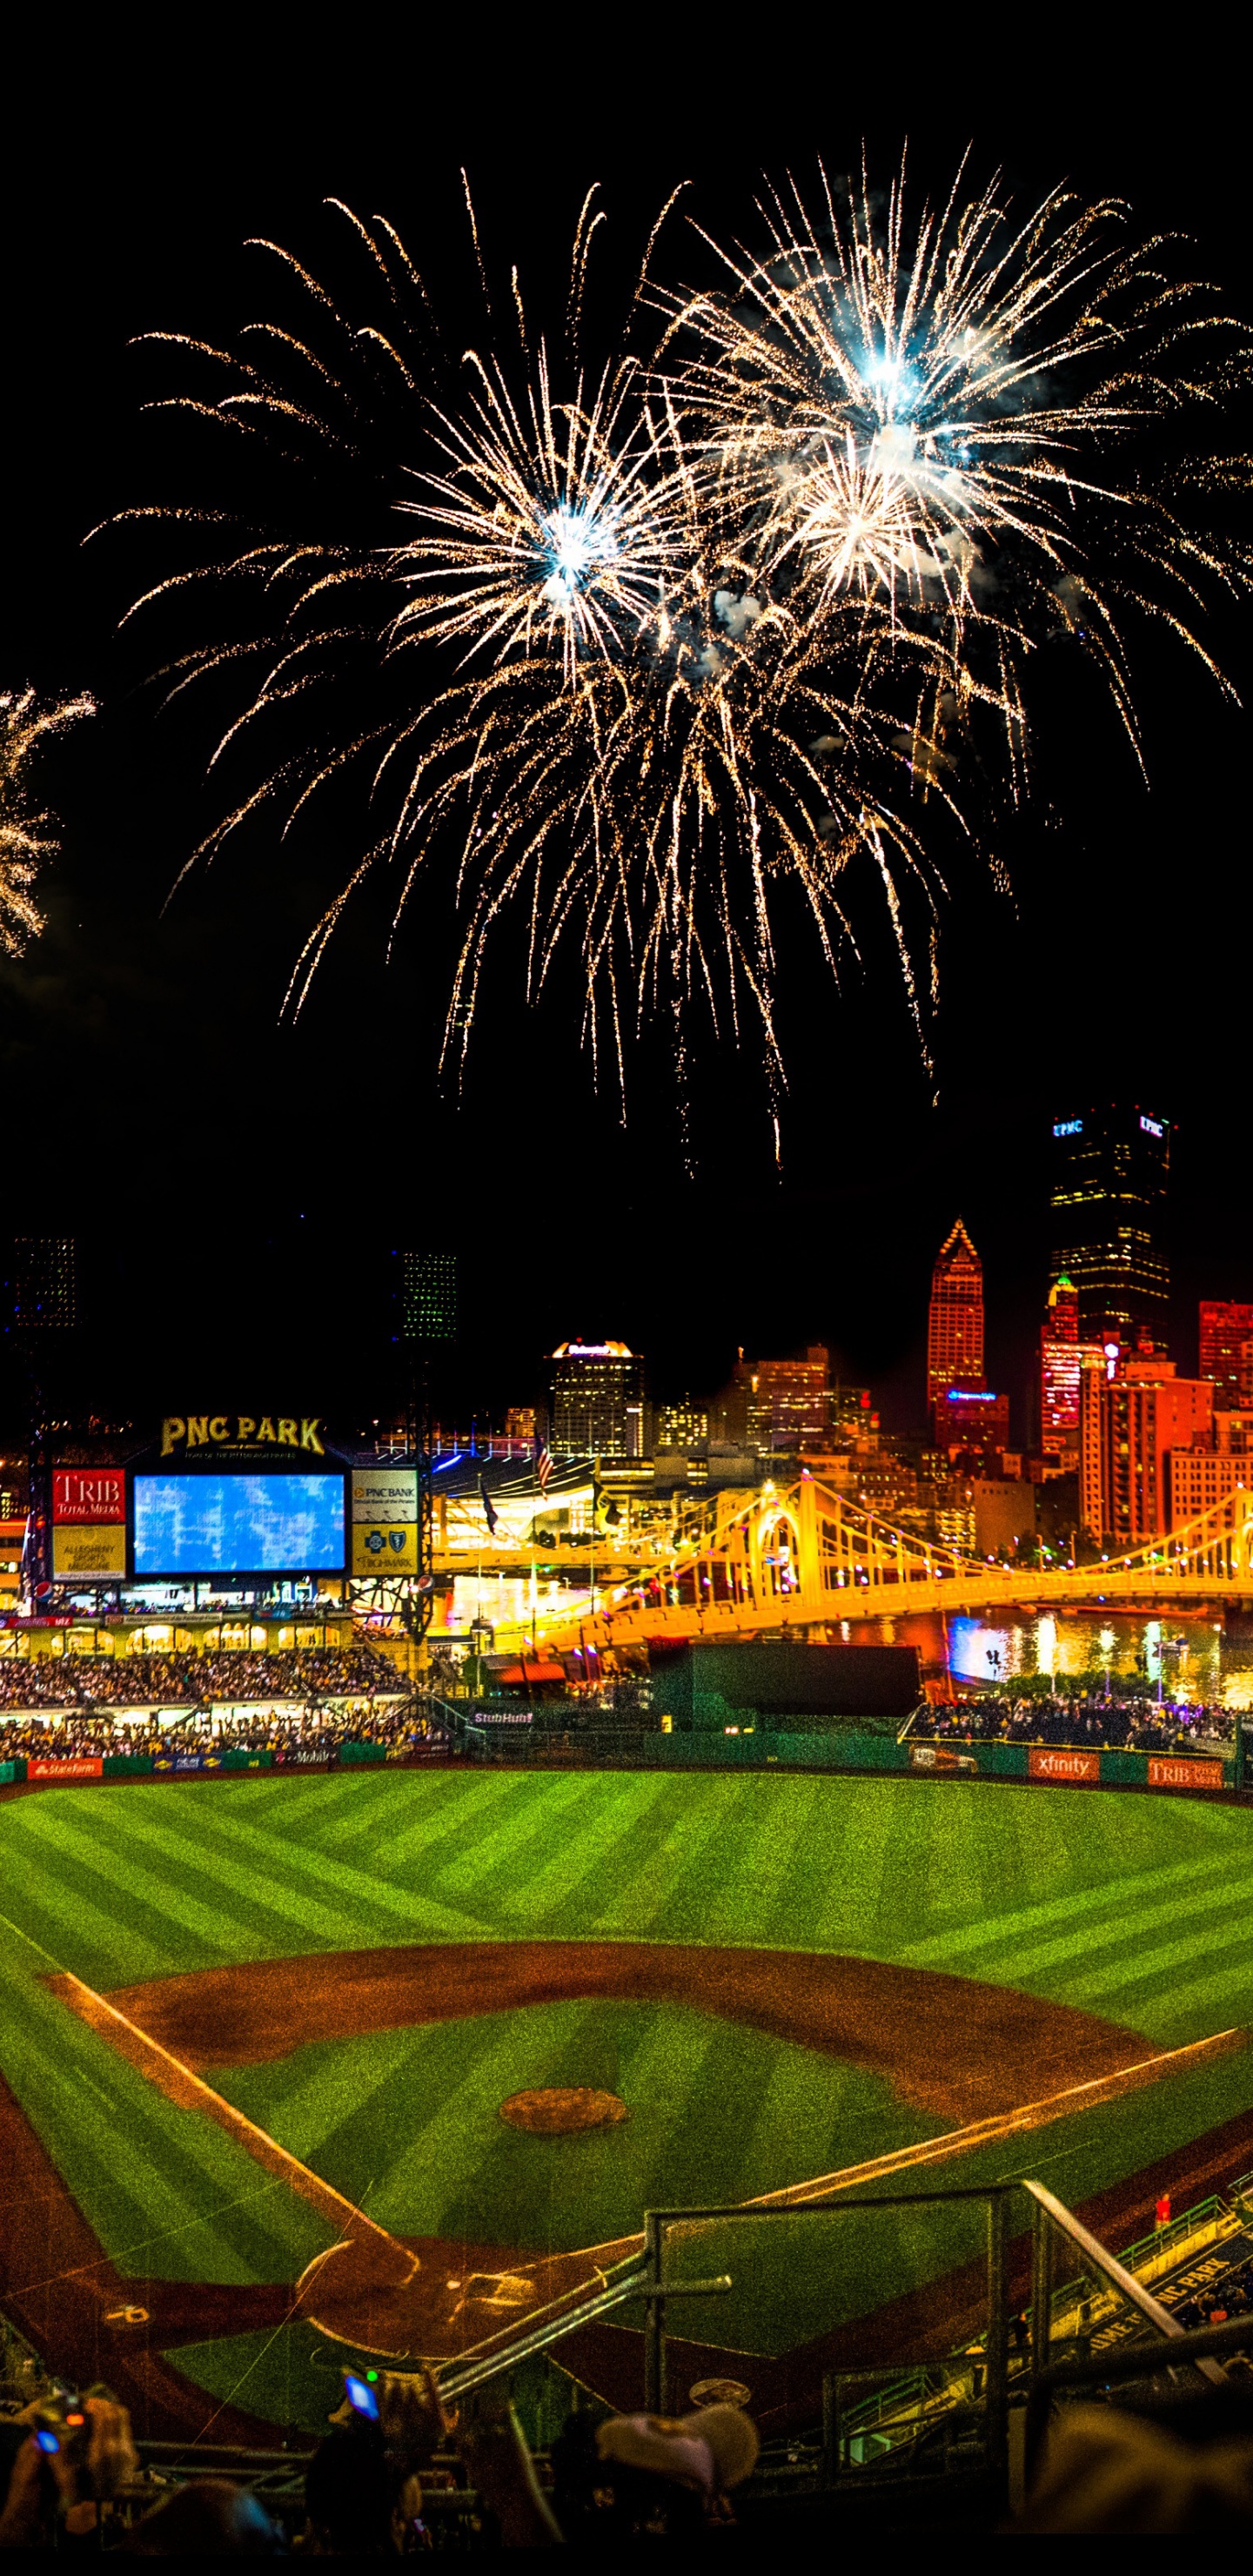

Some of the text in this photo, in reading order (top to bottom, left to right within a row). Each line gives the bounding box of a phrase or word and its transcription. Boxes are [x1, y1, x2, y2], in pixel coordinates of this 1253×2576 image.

[159, 1416, 325, 1458] PNC PARK
[56, 1475, 120, 1503] TRIB
[366, 1488, 415, 1498] PNC BANK
[57, 1503, 120, 1514] TOTAL MEDIA
[474, 1713, 533, 1723] StubHub!
[1039, 1754, 1090, 1776] xfinity
[1149, 1762, 1189, 1782] TRIB
[1176, 2257, 1230, 2289] PARK
